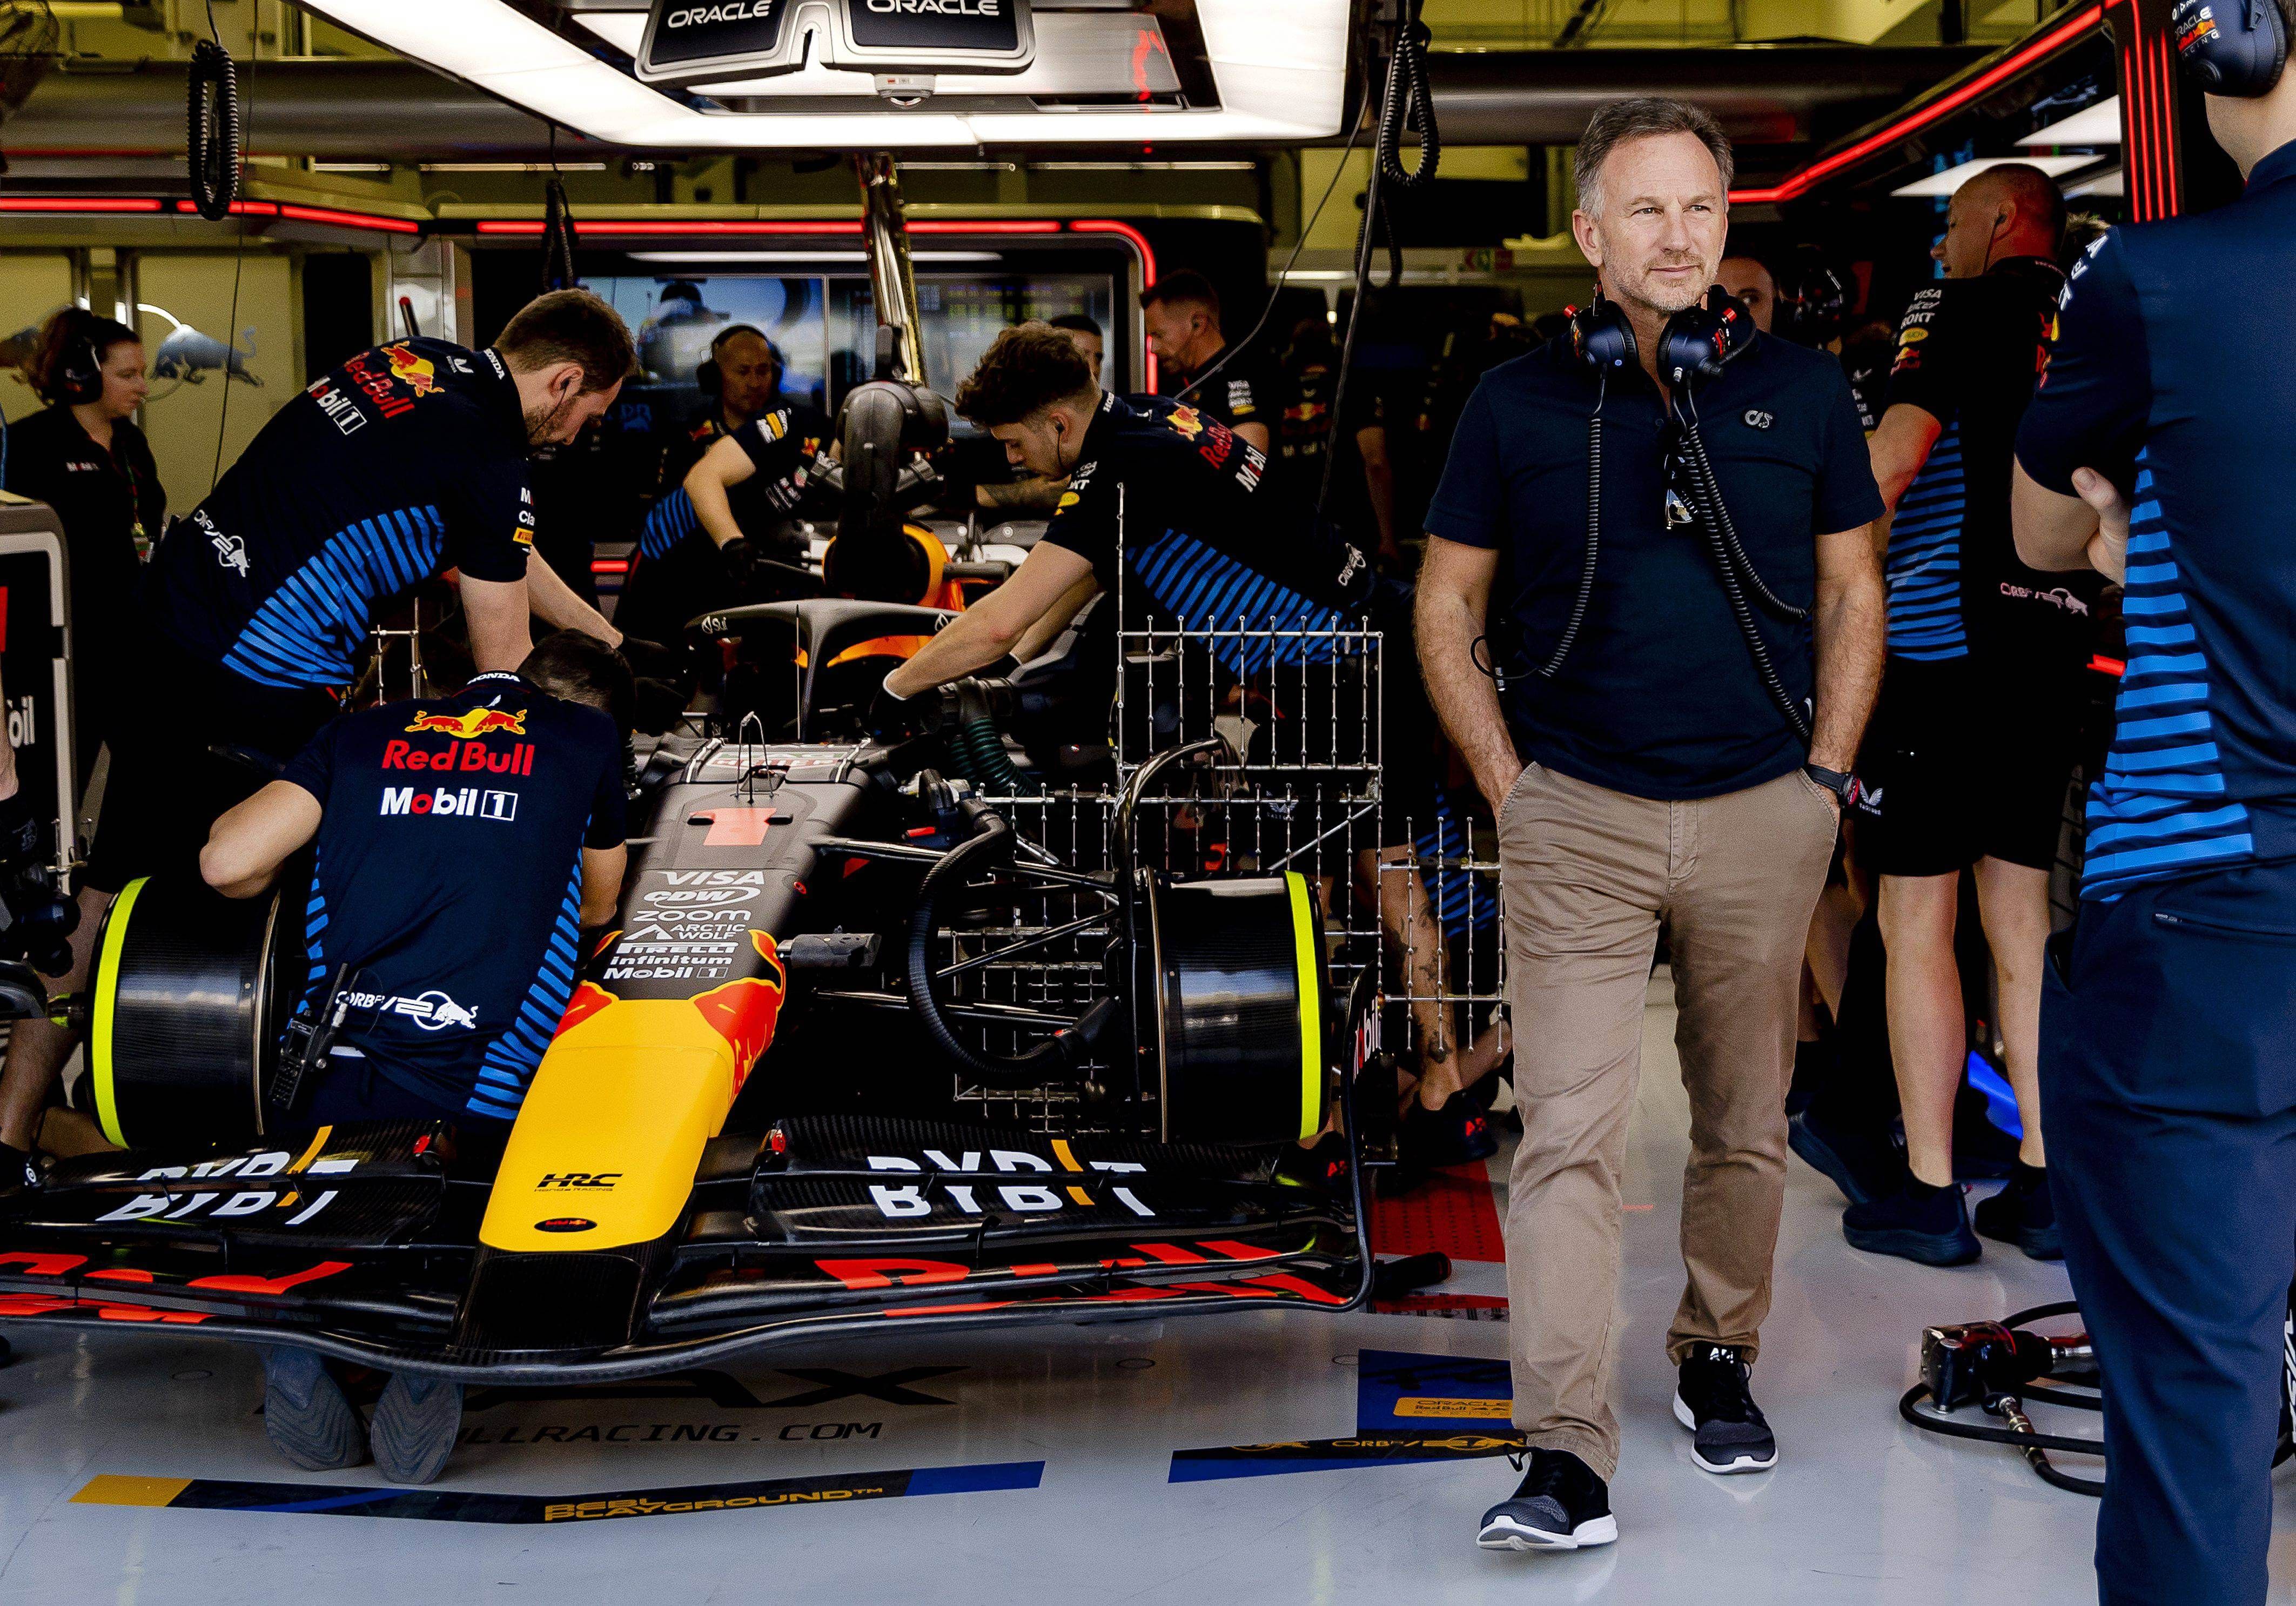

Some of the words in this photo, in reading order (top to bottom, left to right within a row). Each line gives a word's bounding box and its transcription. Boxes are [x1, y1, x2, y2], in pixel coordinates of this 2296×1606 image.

[668, 0, 773, 28] ORACLE
[867, 0, 999, 16] ORACLE
[382, 740, 459, 771] Red
[460, 741, 535, 776] Bull
[380, 787, 479, 816] Mobil
[656, 871, 765, 886] VISA
[670, 924, 746, 933] ARCTIC
[679, 932, 736, 940] WOLF
[616, 941, 739, 954] PIRELLI
[610, 955, 733, 966] infinitum
[603, 967, 694, 980] Mobil
[536, 1173, 623, 1188] HRC
